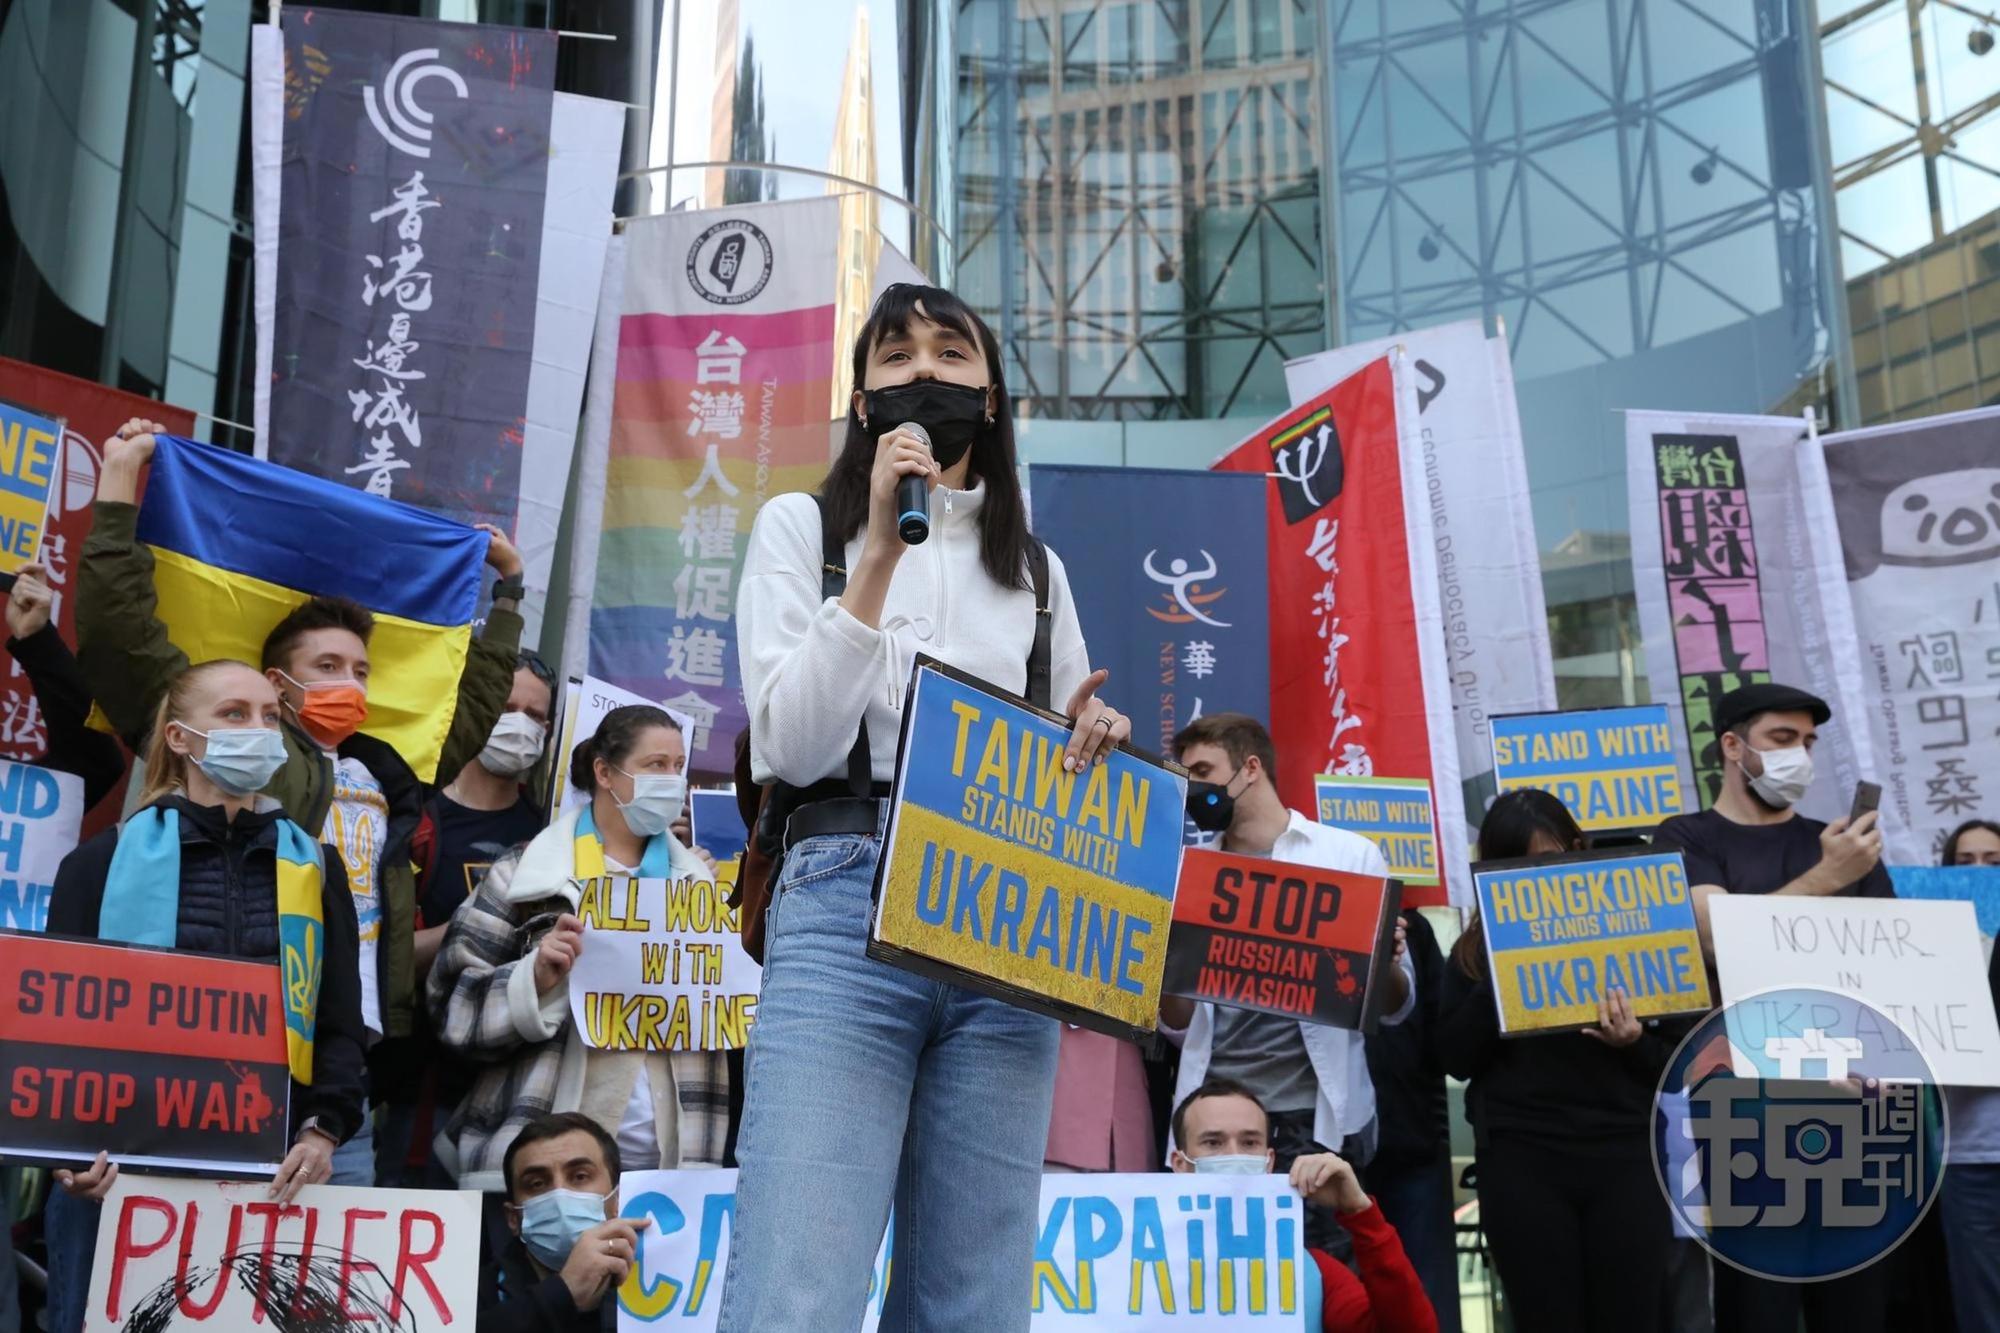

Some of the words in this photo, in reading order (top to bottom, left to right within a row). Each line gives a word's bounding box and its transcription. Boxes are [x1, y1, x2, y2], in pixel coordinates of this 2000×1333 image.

[657, 330, 748, 751] 台灣人權促進會
[1160, 642, 1175, 686] NEW
[1494, 730, 1588, 765] STAND
[1597, 724, 1671, 757] WITH
[950, 699, 1152, 848] TAIWAN
[962, 789, 1054, 852] STANDS
[1063, 828, 1120, 877] WITH
[1320, 797, 1380, 823] STAND
[1387, 801, 1431, 825] WITH
[577, 877, 650, 931] ALL
[915, 840, 1152, 996] UKRAINE
[1210, 867, 1342, 939] STOP
[1490, 863, 1686, 924] HONGKONG
[1530, 914, 1601, 942] STANDS
[1605, 909, 1650, 934] WITH
[1772, 915, 1818, 955] NO
[1830, 916, 1935, 958] WAR
[1207, 941, 1317, 980] RUSSIAN
[1516, 946, 1696, 1011] UKRAINE
[1837, 971, 1862, 990] IN
[18, 969, 131, 1023] STOP
[148, 982, 267, 1037] PUTIN
[1198, 967, 1317, 1016] INVASION
[1736, 1000, 1984, 1054] UKRAINE
[10, 1065, 135, 1124] STOP
[156, 1076, 261, 1133] WAR
